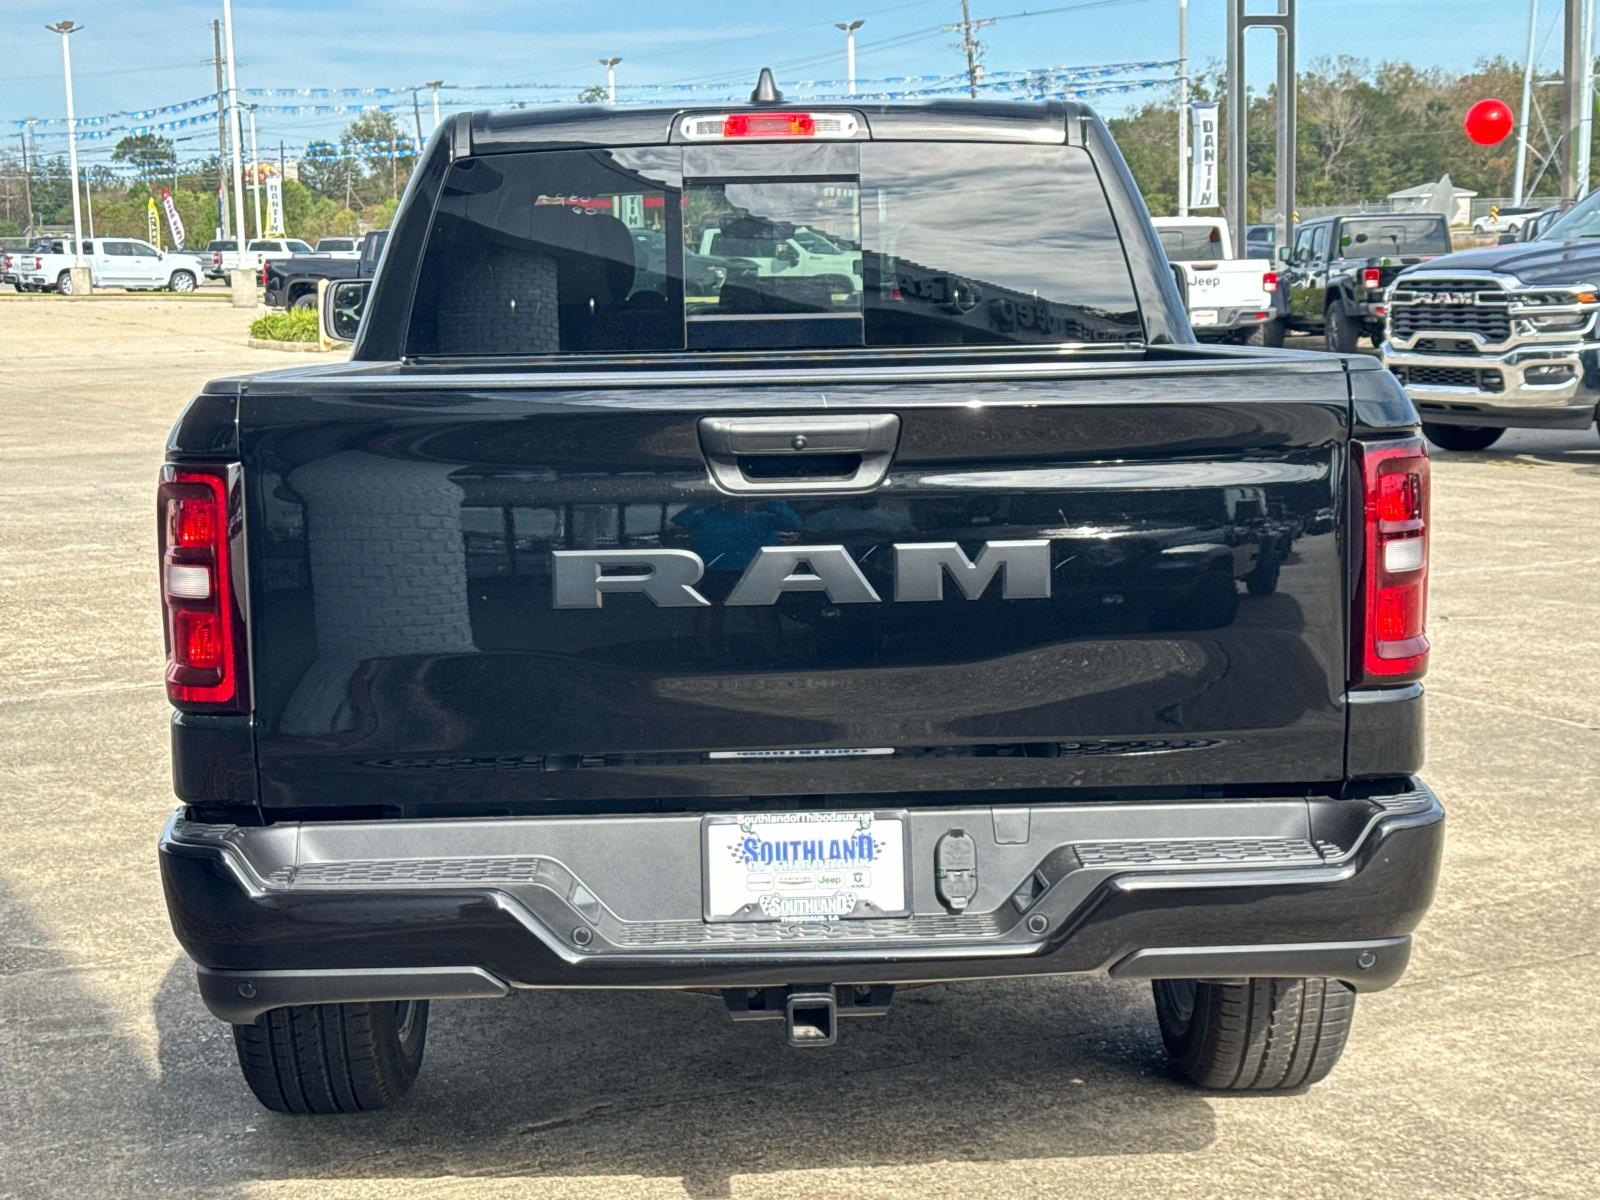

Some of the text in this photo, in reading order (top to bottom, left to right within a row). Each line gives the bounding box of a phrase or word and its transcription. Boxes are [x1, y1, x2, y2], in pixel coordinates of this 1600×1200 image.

[1200, 120, 1214, 205] DANTIN
[1188, 276, 1220, 288] Jeep
[1415, 291, 1475, 304] RAM
[551, 539, 1051, 609] RAM
[736, 812, 875, 825] SouthlandofThibodaux.net
[818, 875, 841, 885] Jeep
